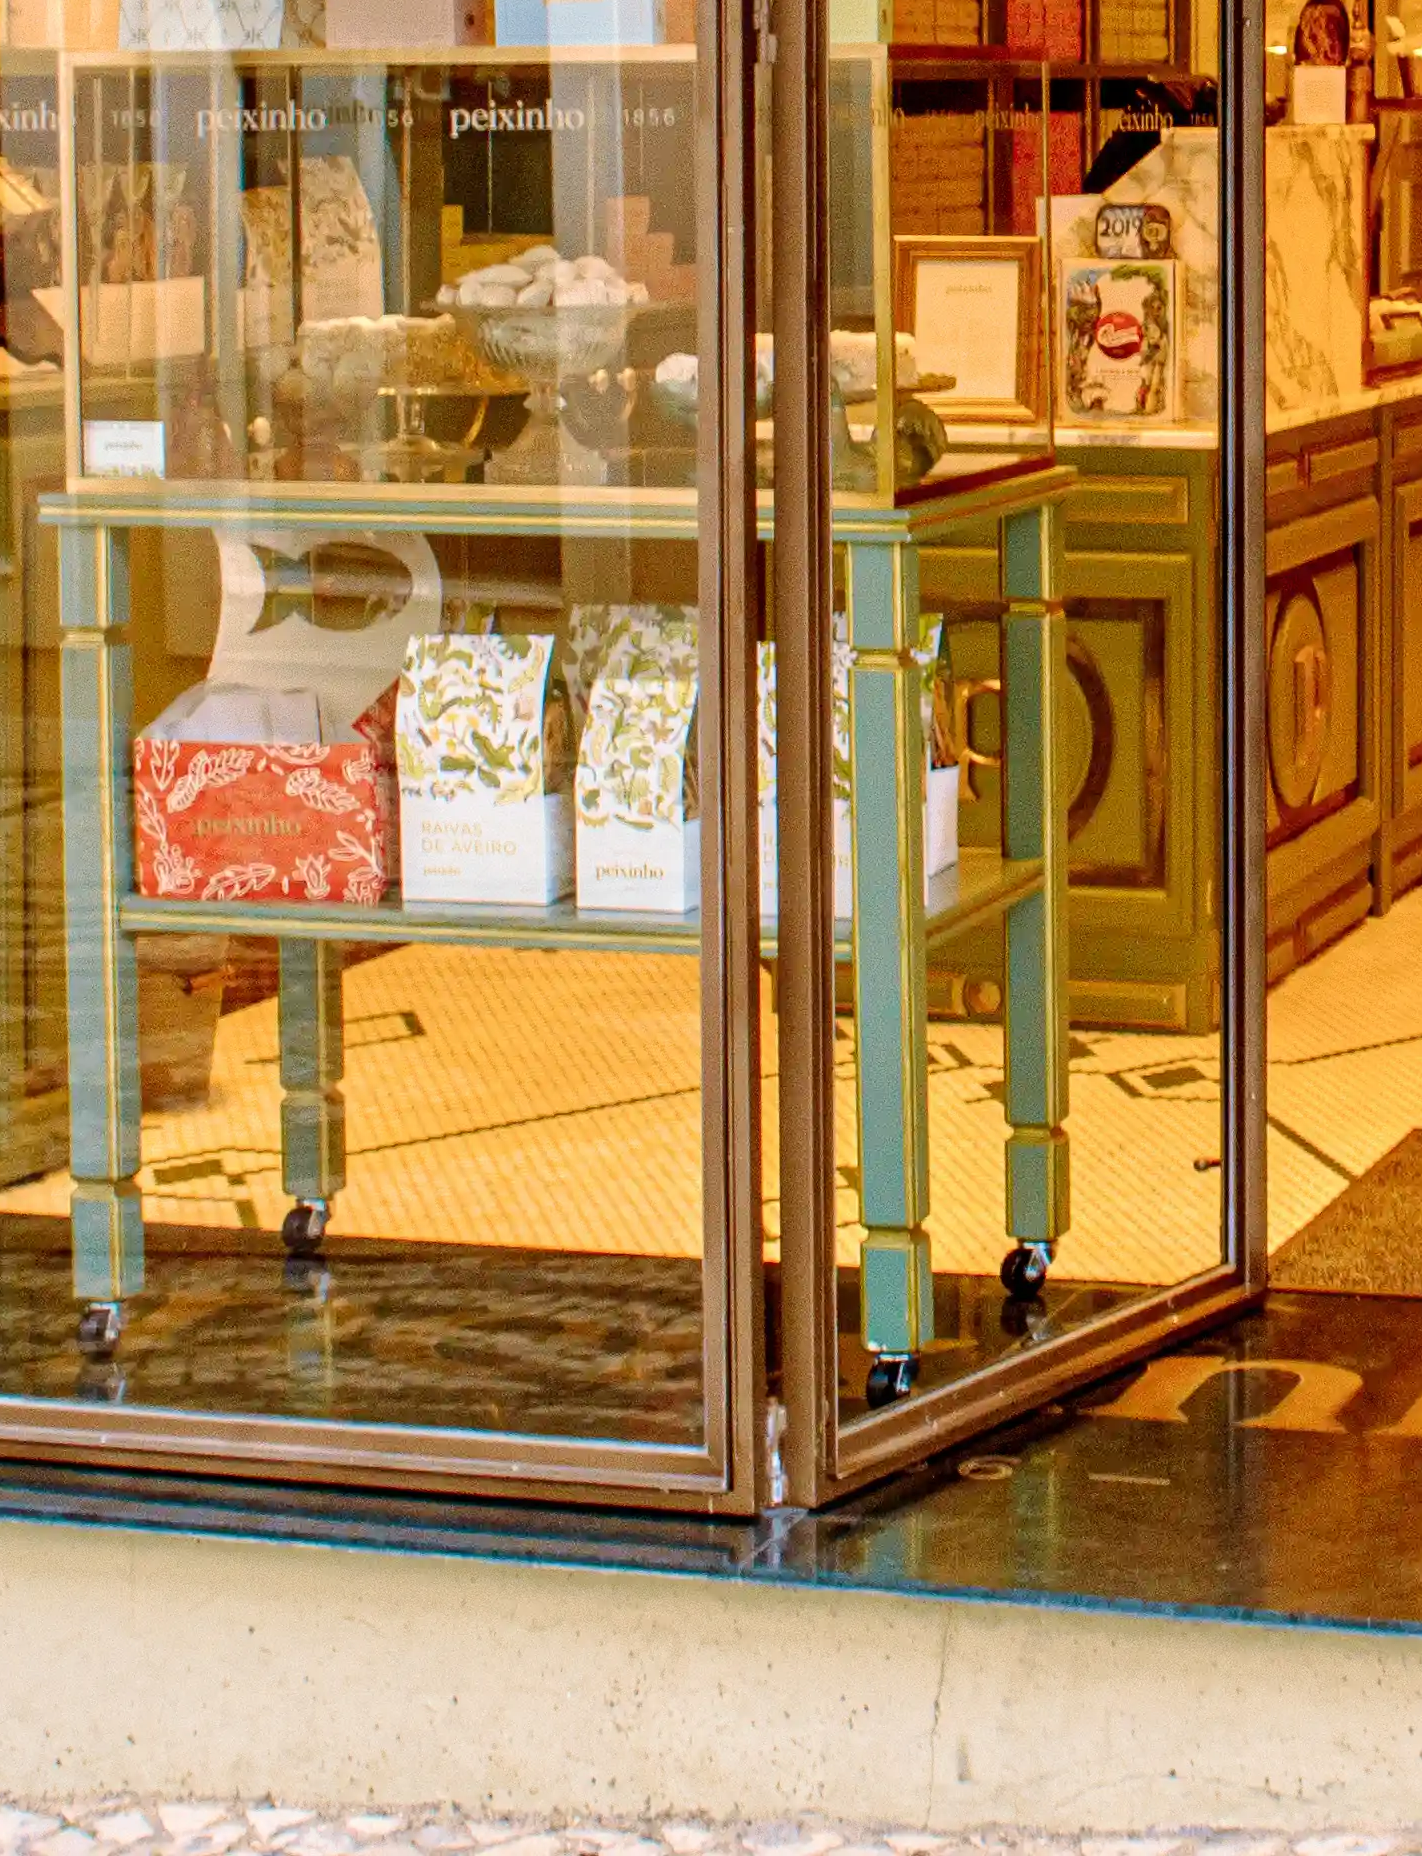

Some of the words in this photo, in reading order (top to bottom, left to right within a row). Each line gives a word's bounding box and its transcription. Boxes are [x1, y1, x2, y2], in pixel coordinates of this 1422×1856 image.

[196, 98, 327, 139] peixinho
[449, 98, 586, 140] peixinho
[1098, 216, 1143, 238] 2019
[421, 819, 484, 838] RAIVAS
[421, 838, 445, 854] DE
[451, 839, 518, 857] AVEIRO
[595, 861, 665, 881] peixinho
